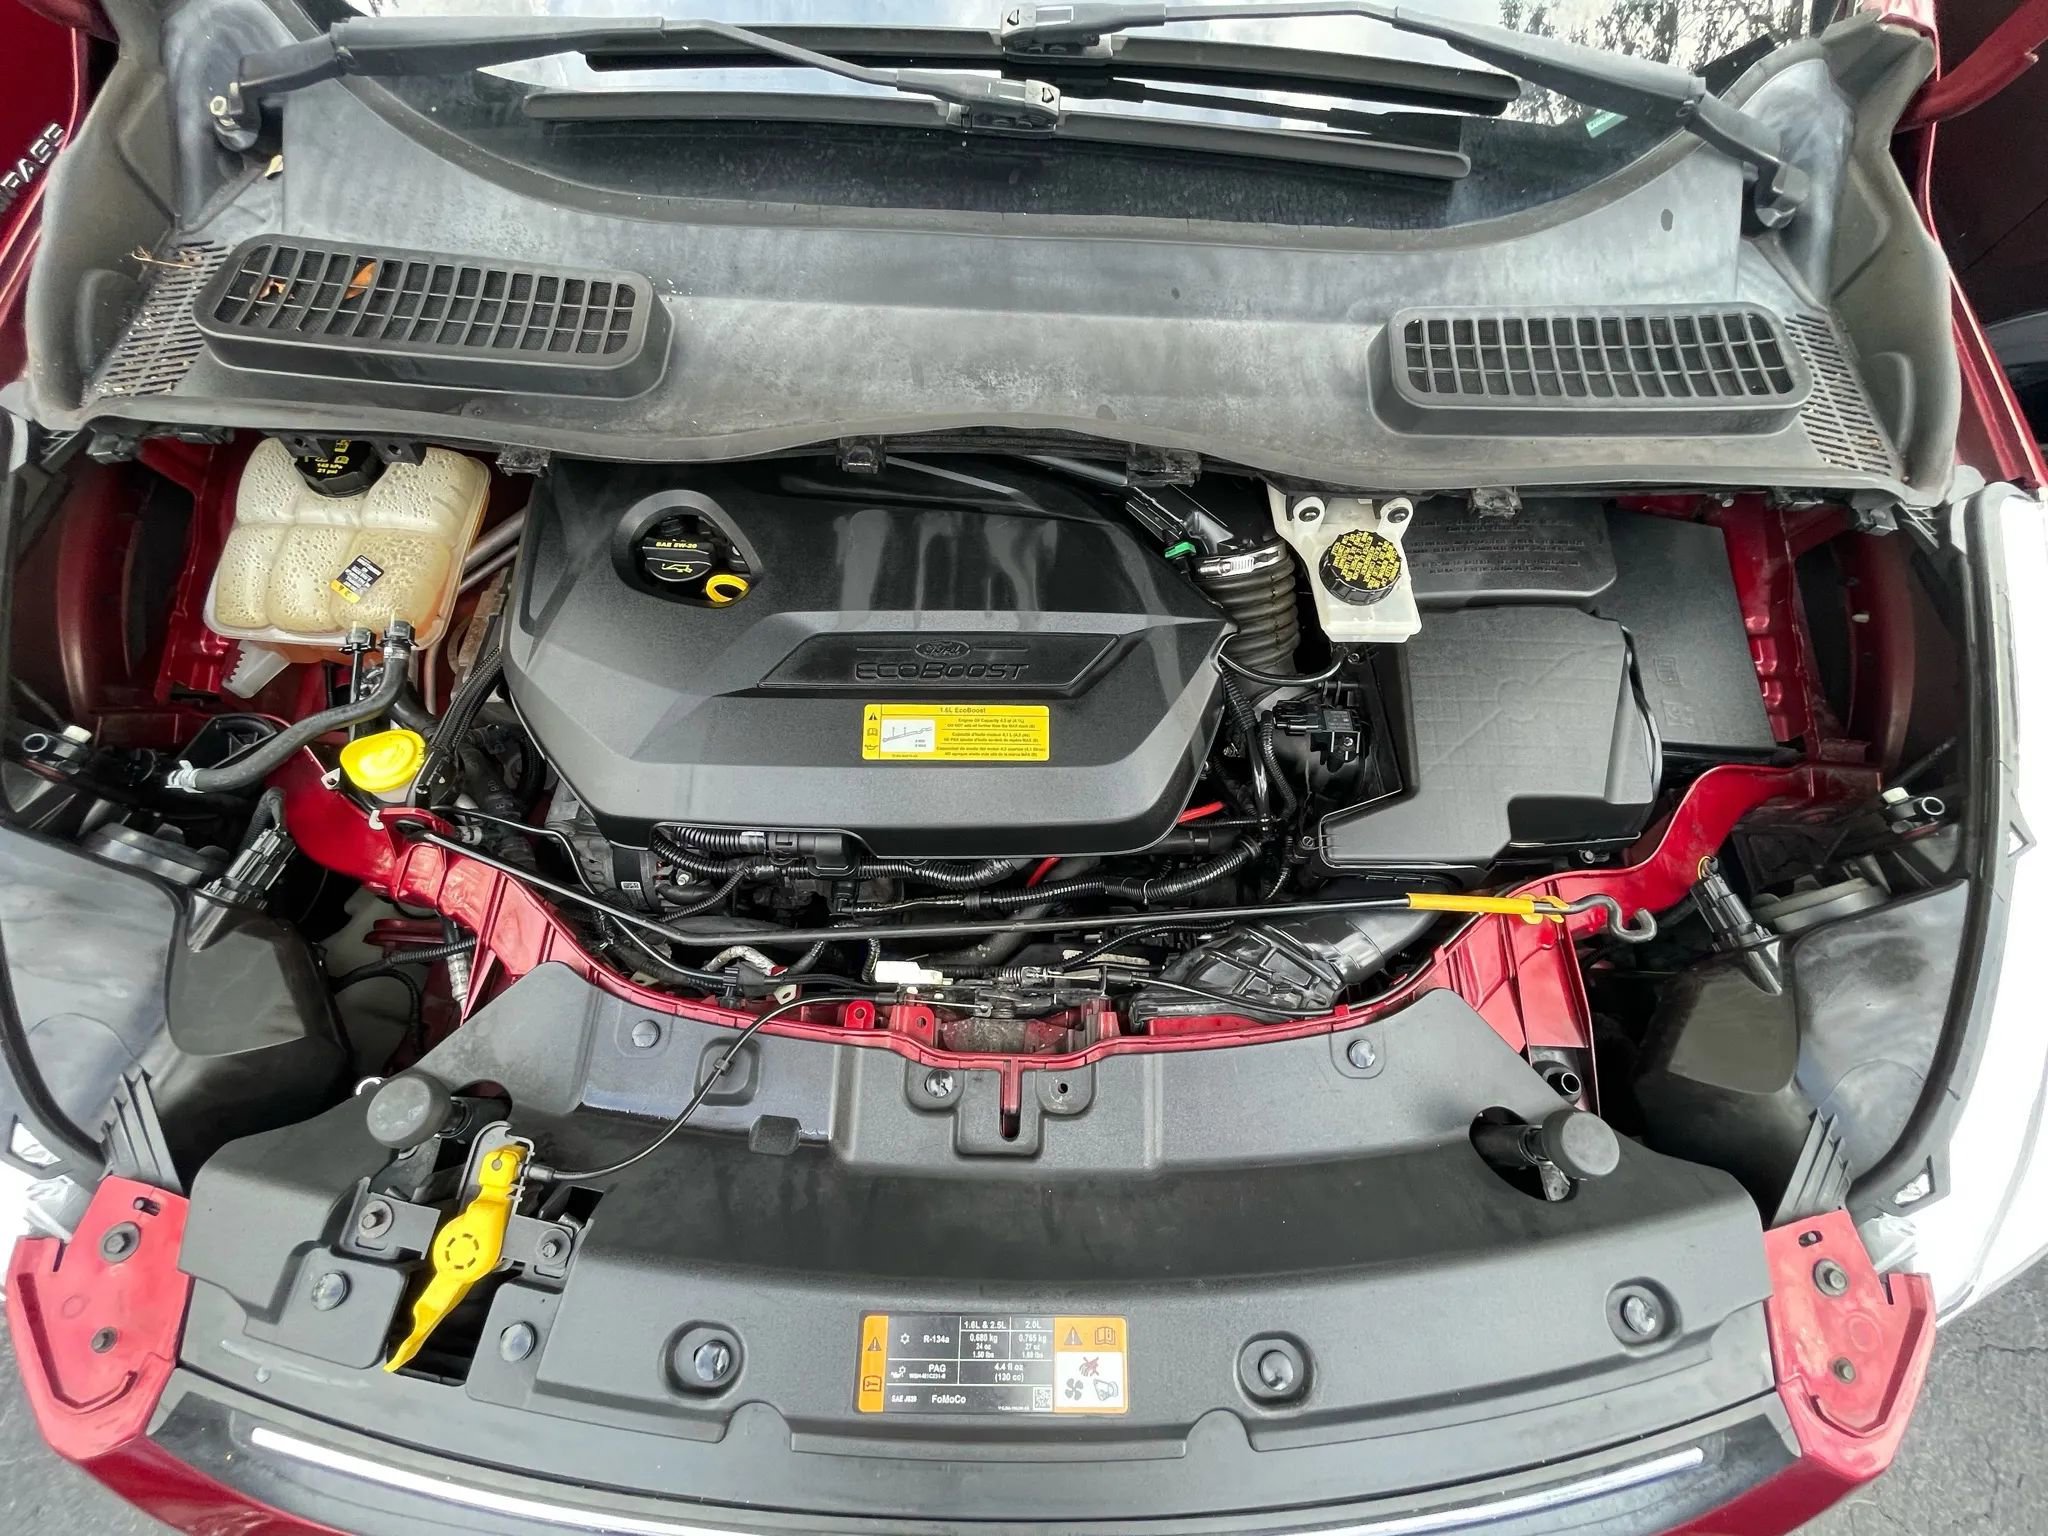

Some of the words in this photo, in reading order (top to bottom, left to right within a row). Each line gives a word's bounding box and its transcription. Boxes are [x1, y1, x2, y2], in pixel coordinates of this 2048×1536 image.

[923, 642, 962, 658] Ford
[964, 1320, 981, 1329] 1.6L
[982, 1320, 989, 1329] &
[990, 1320, 1007, 1329] 2.5L
[1025, 1320, 1042, 1329] 2.0L
[923, 1335, 950, 1344] R-134a
[989, 1333, 998, 1344] kg
[1039, 1333, 1048, 1344] kg
[928, 1364, 947, 1373] PAG
[994, 1363, 1006, 1371] 4.4
[891, 1395, 903, 1403] SAE
[931, 1394, 967, 1404] FoMoCo
